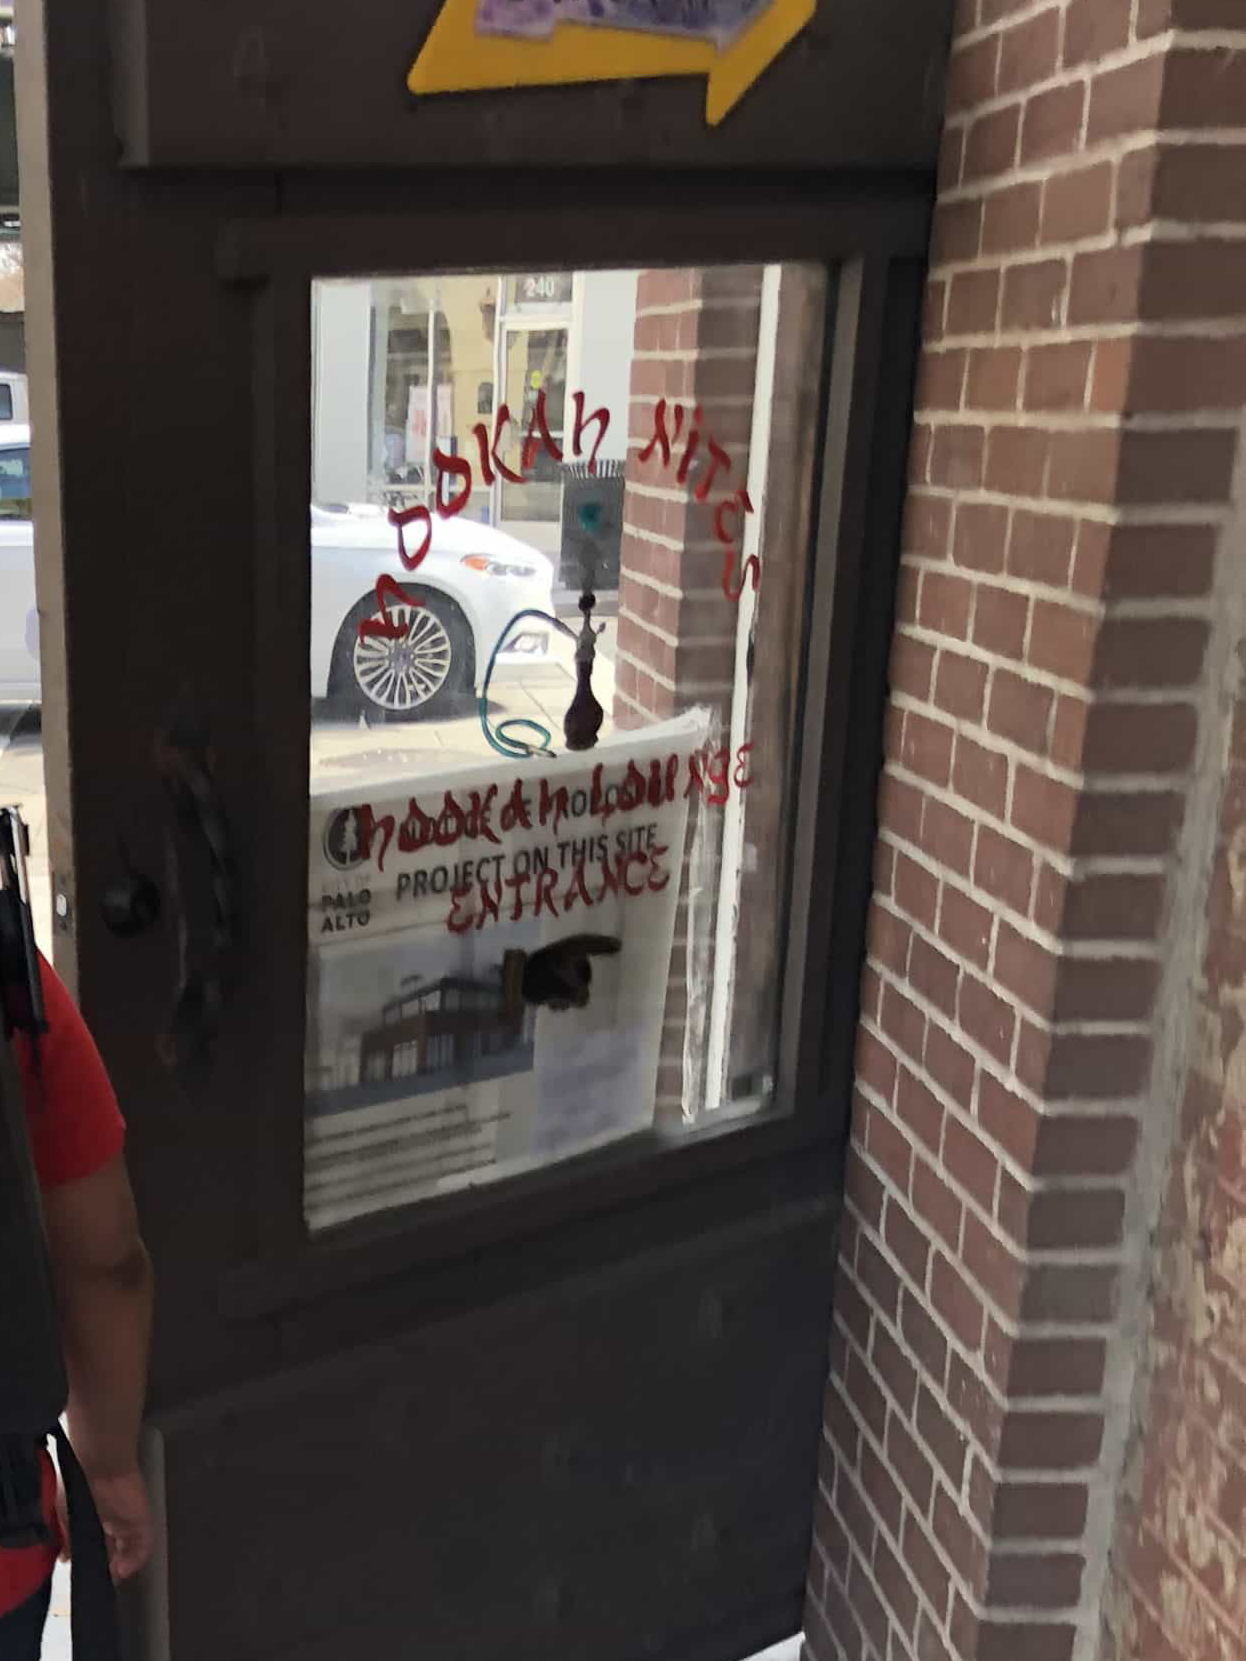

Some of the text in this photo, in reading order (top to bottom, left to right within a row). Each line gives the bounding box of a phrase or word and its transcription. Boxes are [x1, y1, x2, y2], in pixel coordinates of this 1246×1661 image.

[395, 854, 506, 901] PROJECT
[513, 843, 552, 878] ON
[556, 833, 610, 868] THIS
[616, 823, 659, 855] SITE
[321, 888, 373, 911] PALO
[446, 844, 671, 934] ENTRANCE
[321, 909, 372, 934] ALTO
